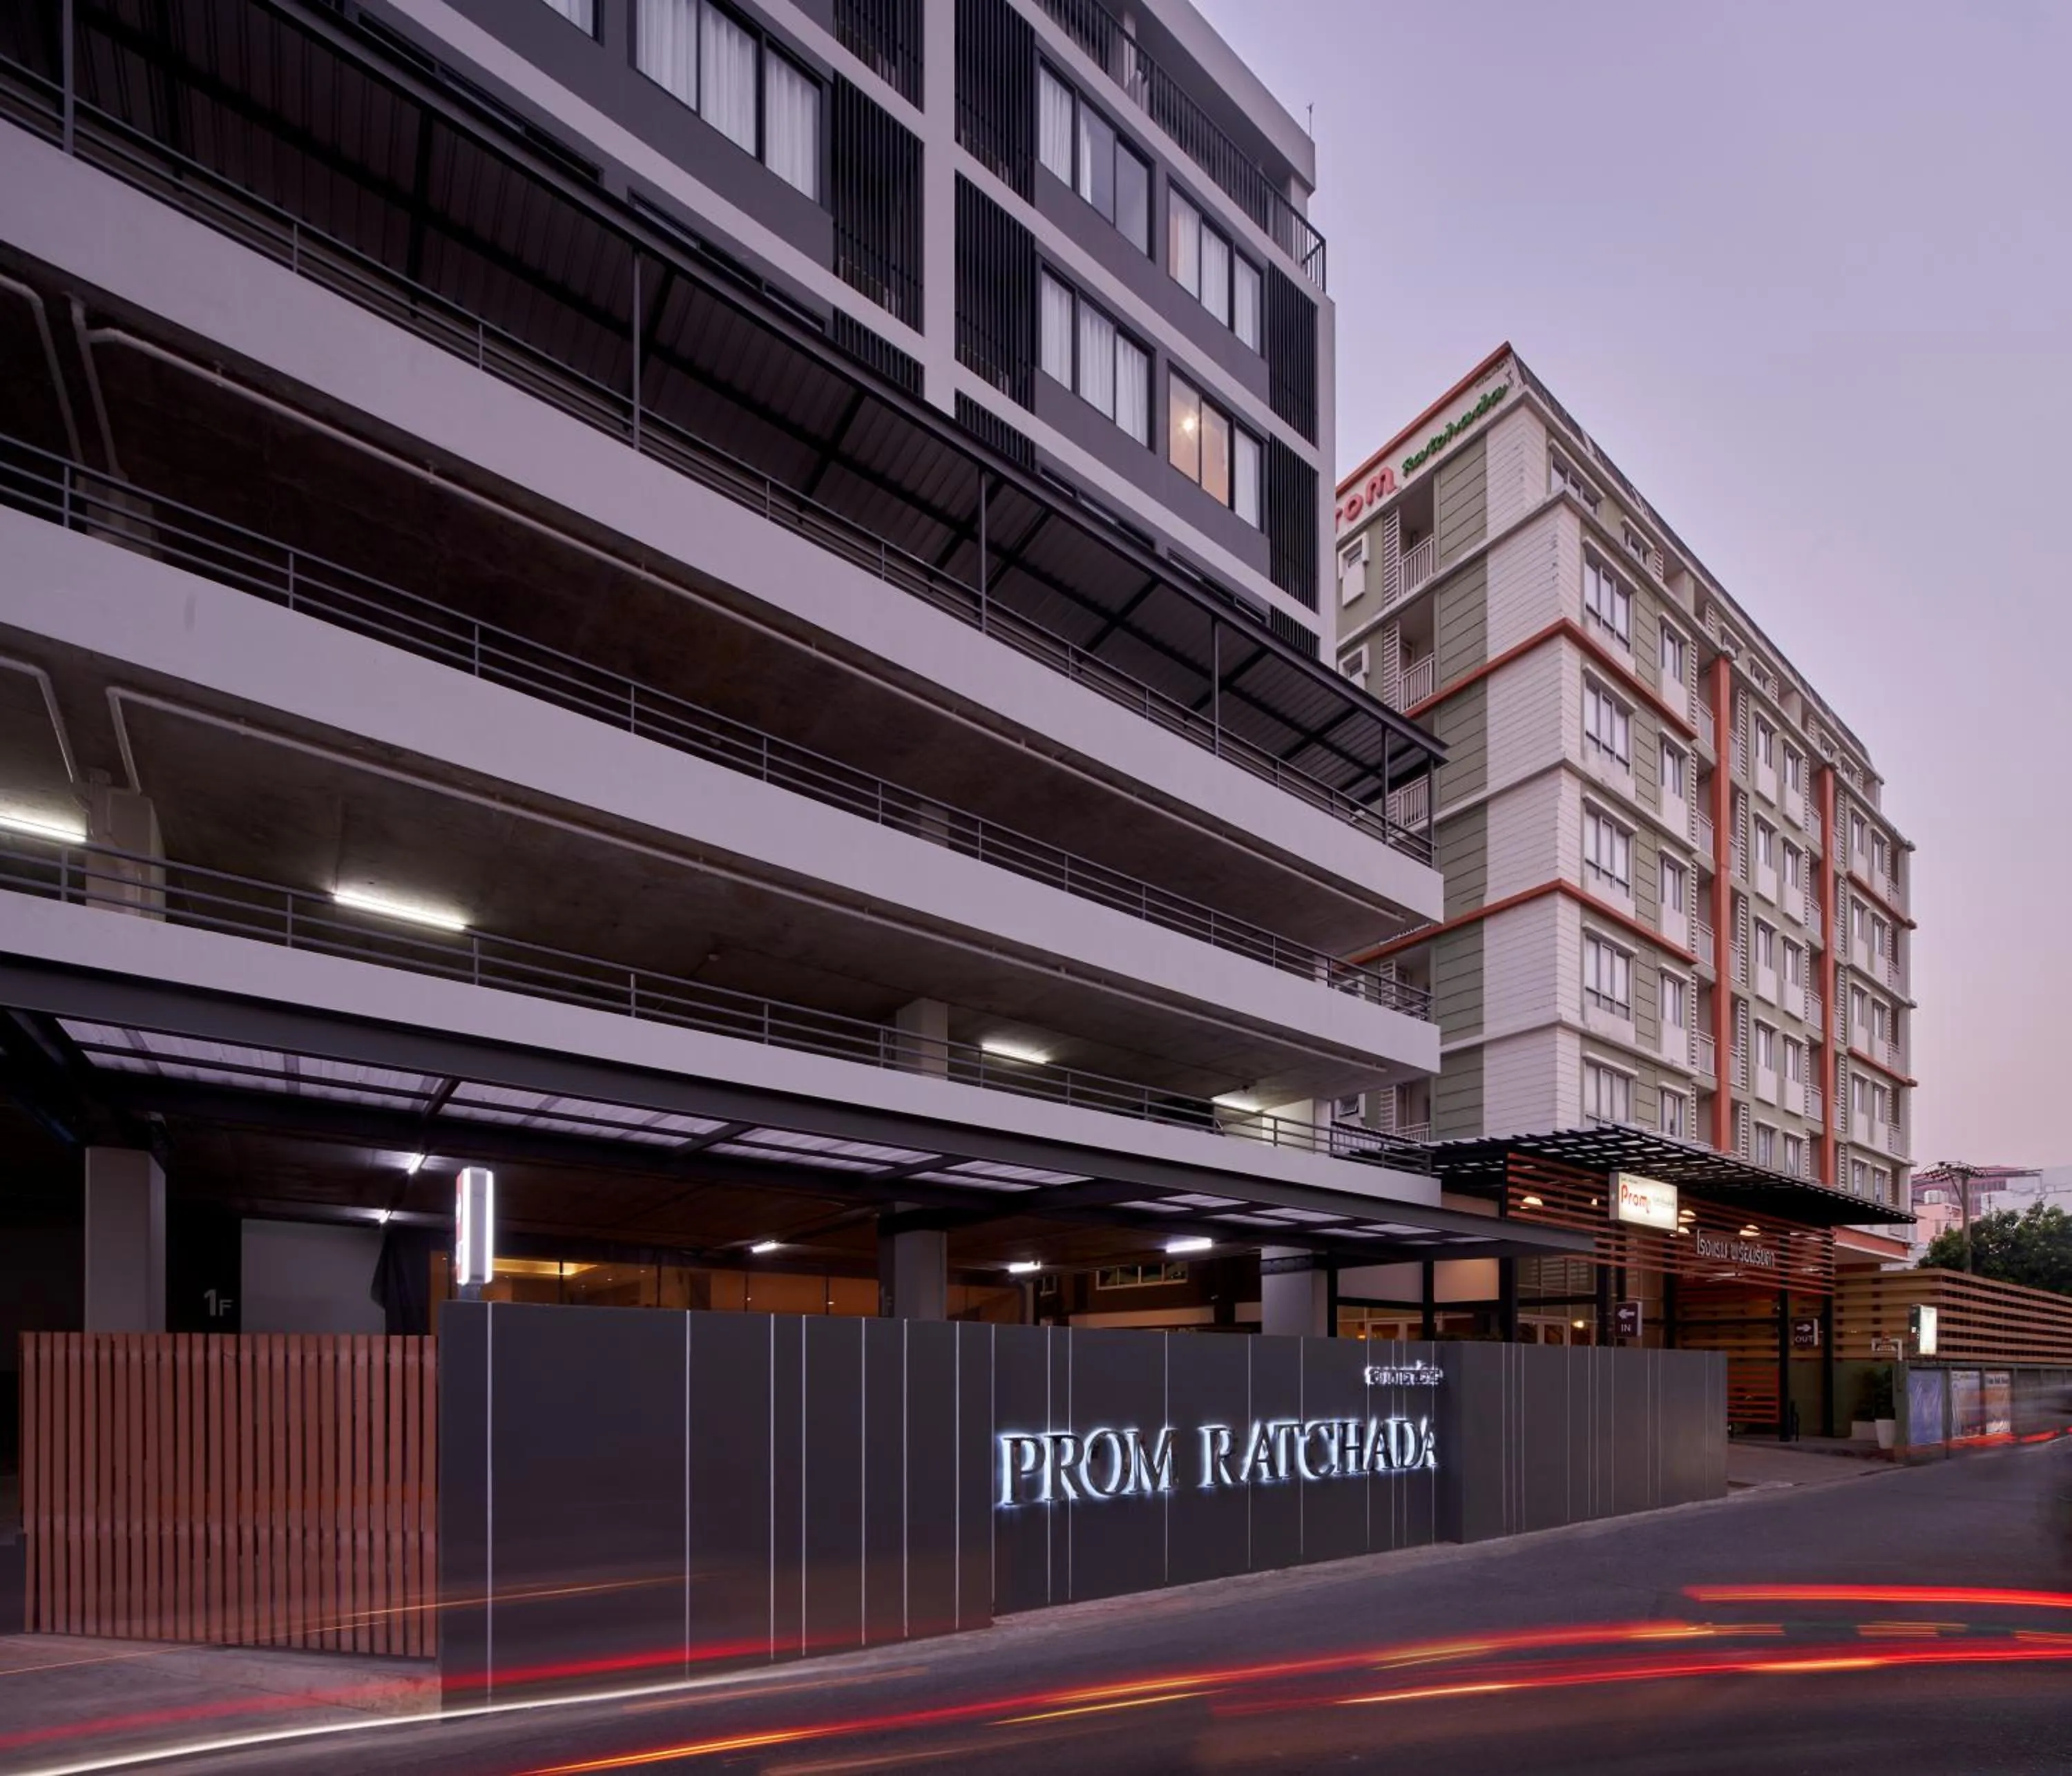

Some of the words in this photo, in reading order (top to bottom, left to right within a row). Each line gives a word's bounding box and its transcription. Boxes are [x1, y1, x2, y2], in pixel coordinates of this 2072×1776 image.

[1335, 466, 1398, 533] rom
[203, 1288, 233, 1316] 1F
[1621, 1324, 1631, 1332] IN
[999, 1427, 1177, 1506] PROM
[1199, 1417, 1439, 1486] RATCHADA
